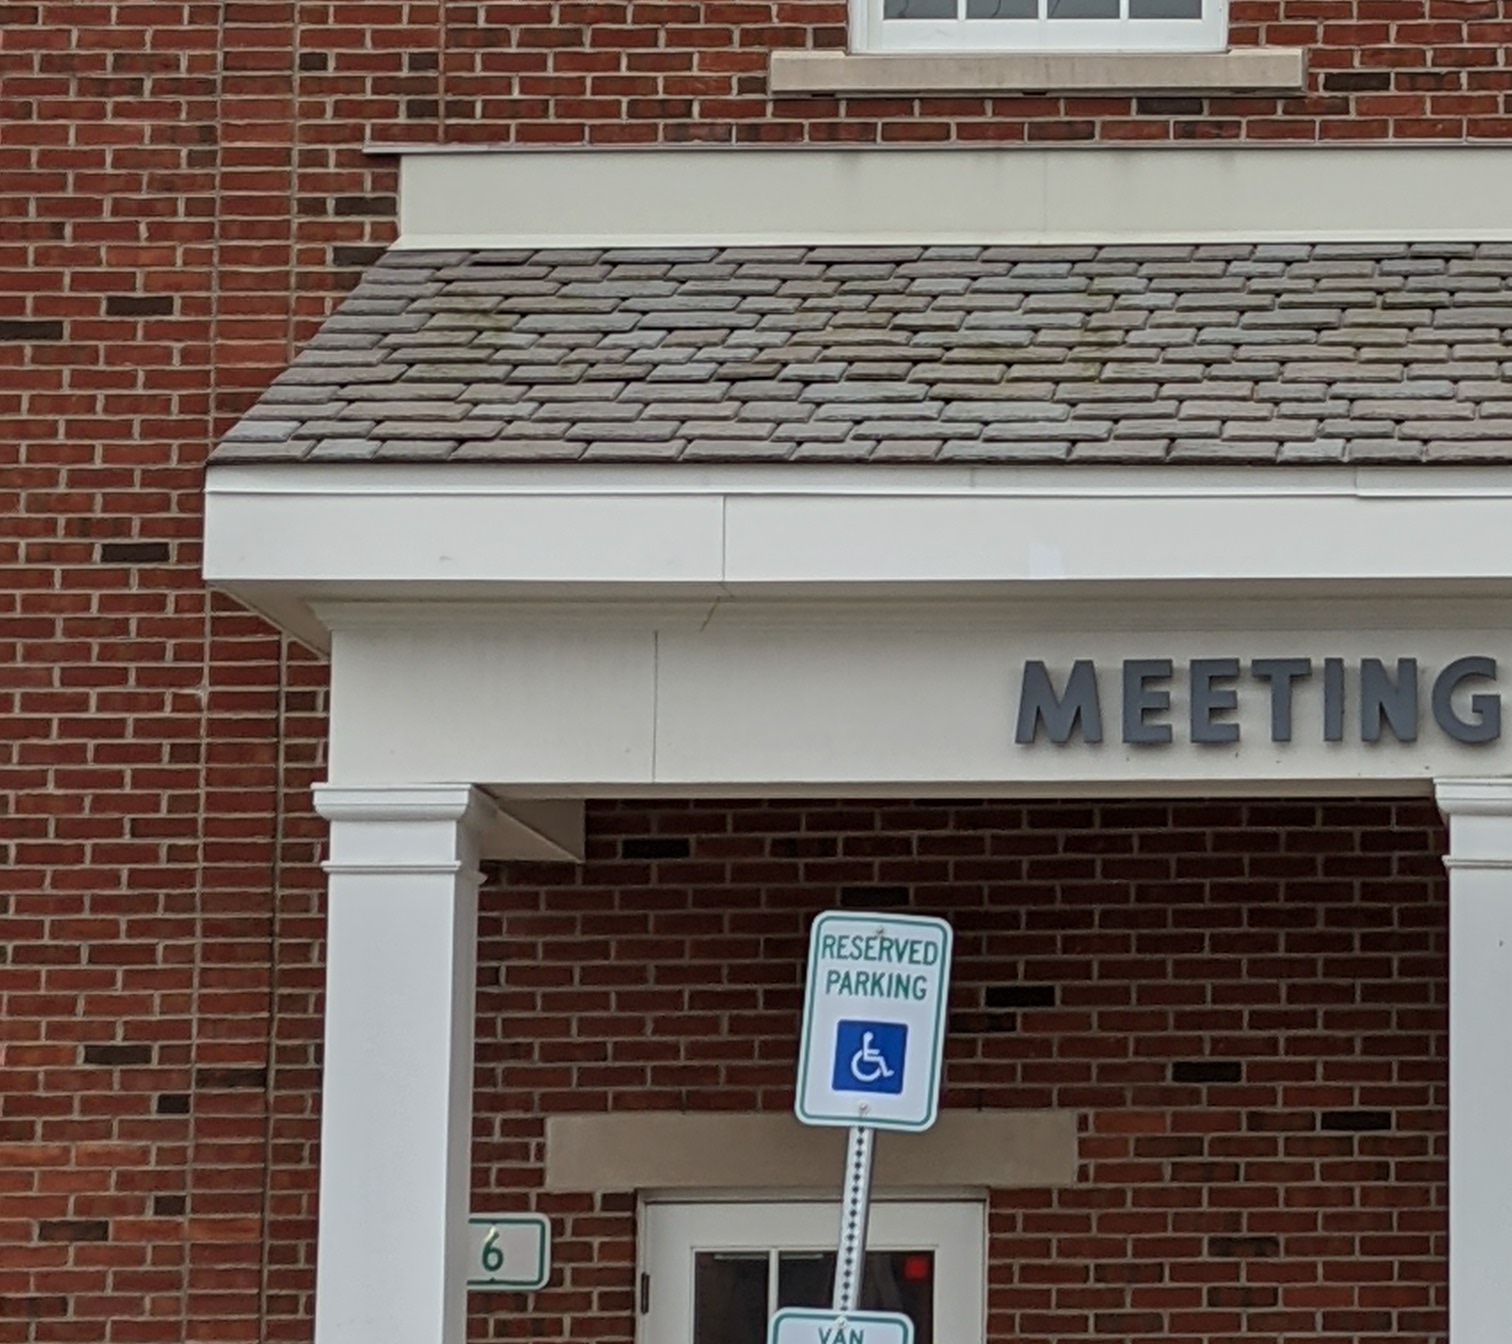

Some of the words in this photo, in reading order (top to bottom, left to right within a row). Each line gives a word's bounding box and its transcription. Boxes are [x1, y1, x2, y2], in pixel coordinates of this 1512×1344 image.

[1014, 656, 1501, 746] MEETING
[821, 934, 939, 966] RESERVED
[825, 969, 927, 1001] PARKING
[482, 1229, 503, 1271] 6
